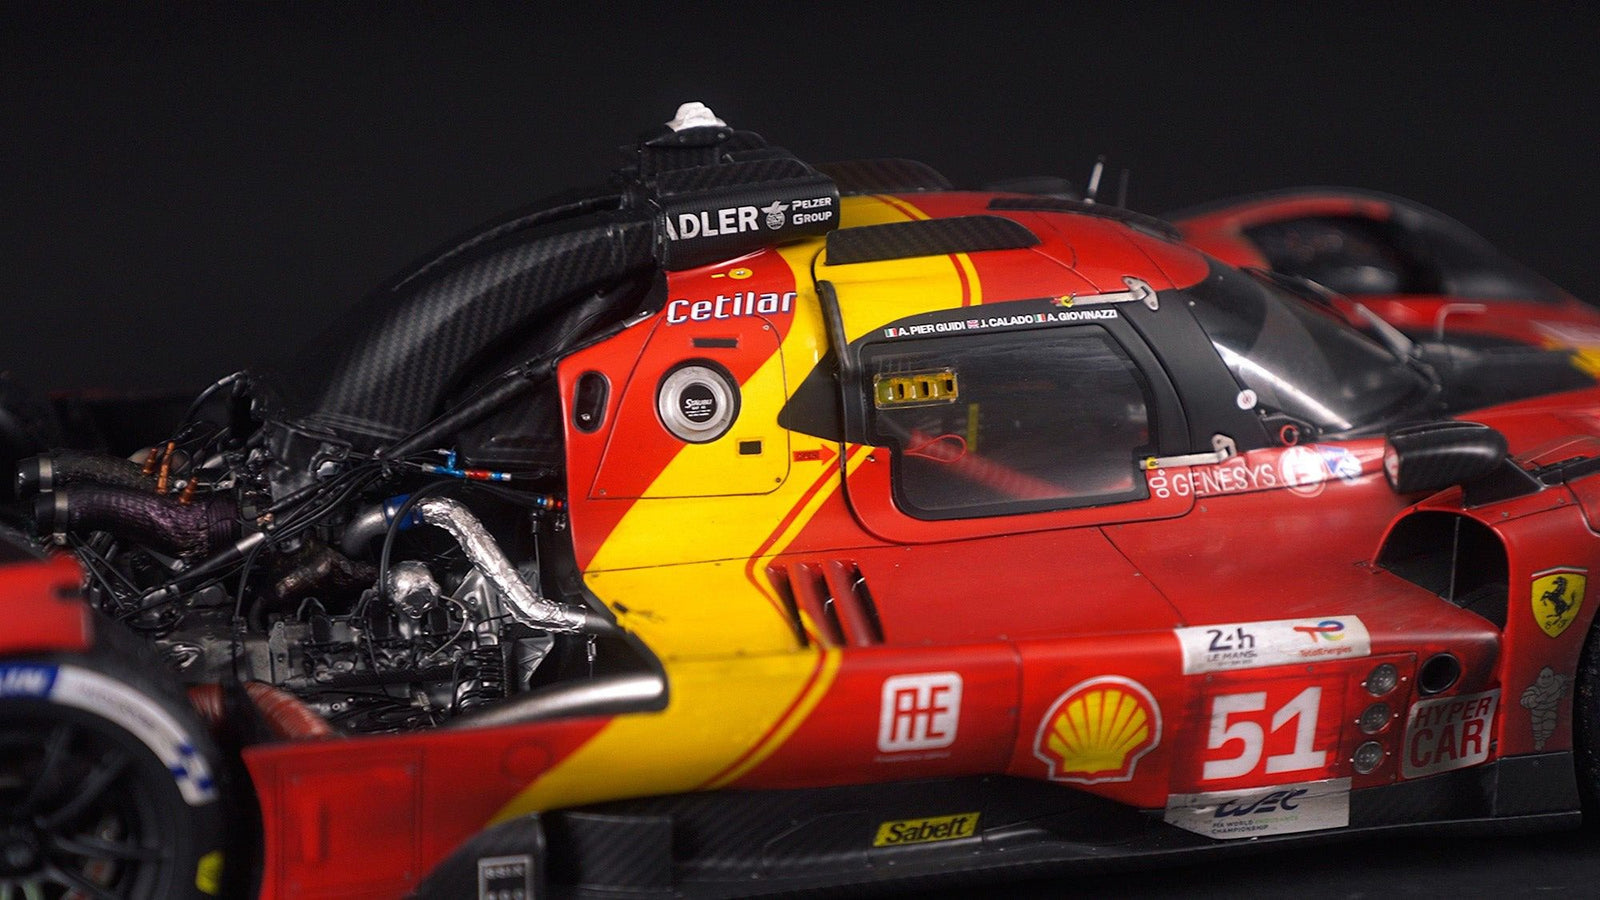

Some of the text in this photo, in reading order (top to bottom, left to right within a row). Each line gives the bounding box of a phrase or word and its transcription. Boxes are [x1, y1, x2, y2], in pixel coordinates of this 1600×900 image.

[792, 197, 832, 211] PELZER
[792, 211, 832, 225] GROUP
[666, 291, 798, 324] Cetilar
[988, 314, 1034, 327] CALADO
[1047, 309, 1118, 322] A. GIOVINAZZI
[898, 321, 965, 336] A. PIER GUIDI
[1172, 463, 1276, 496] GENESYS
[1414, 696, 1493, 729] HYPER
[1203, 686, 1328, 781] 51
[1410, 719, 1485, 768] CAR
[885, 817, 968, 844] Sabelt
